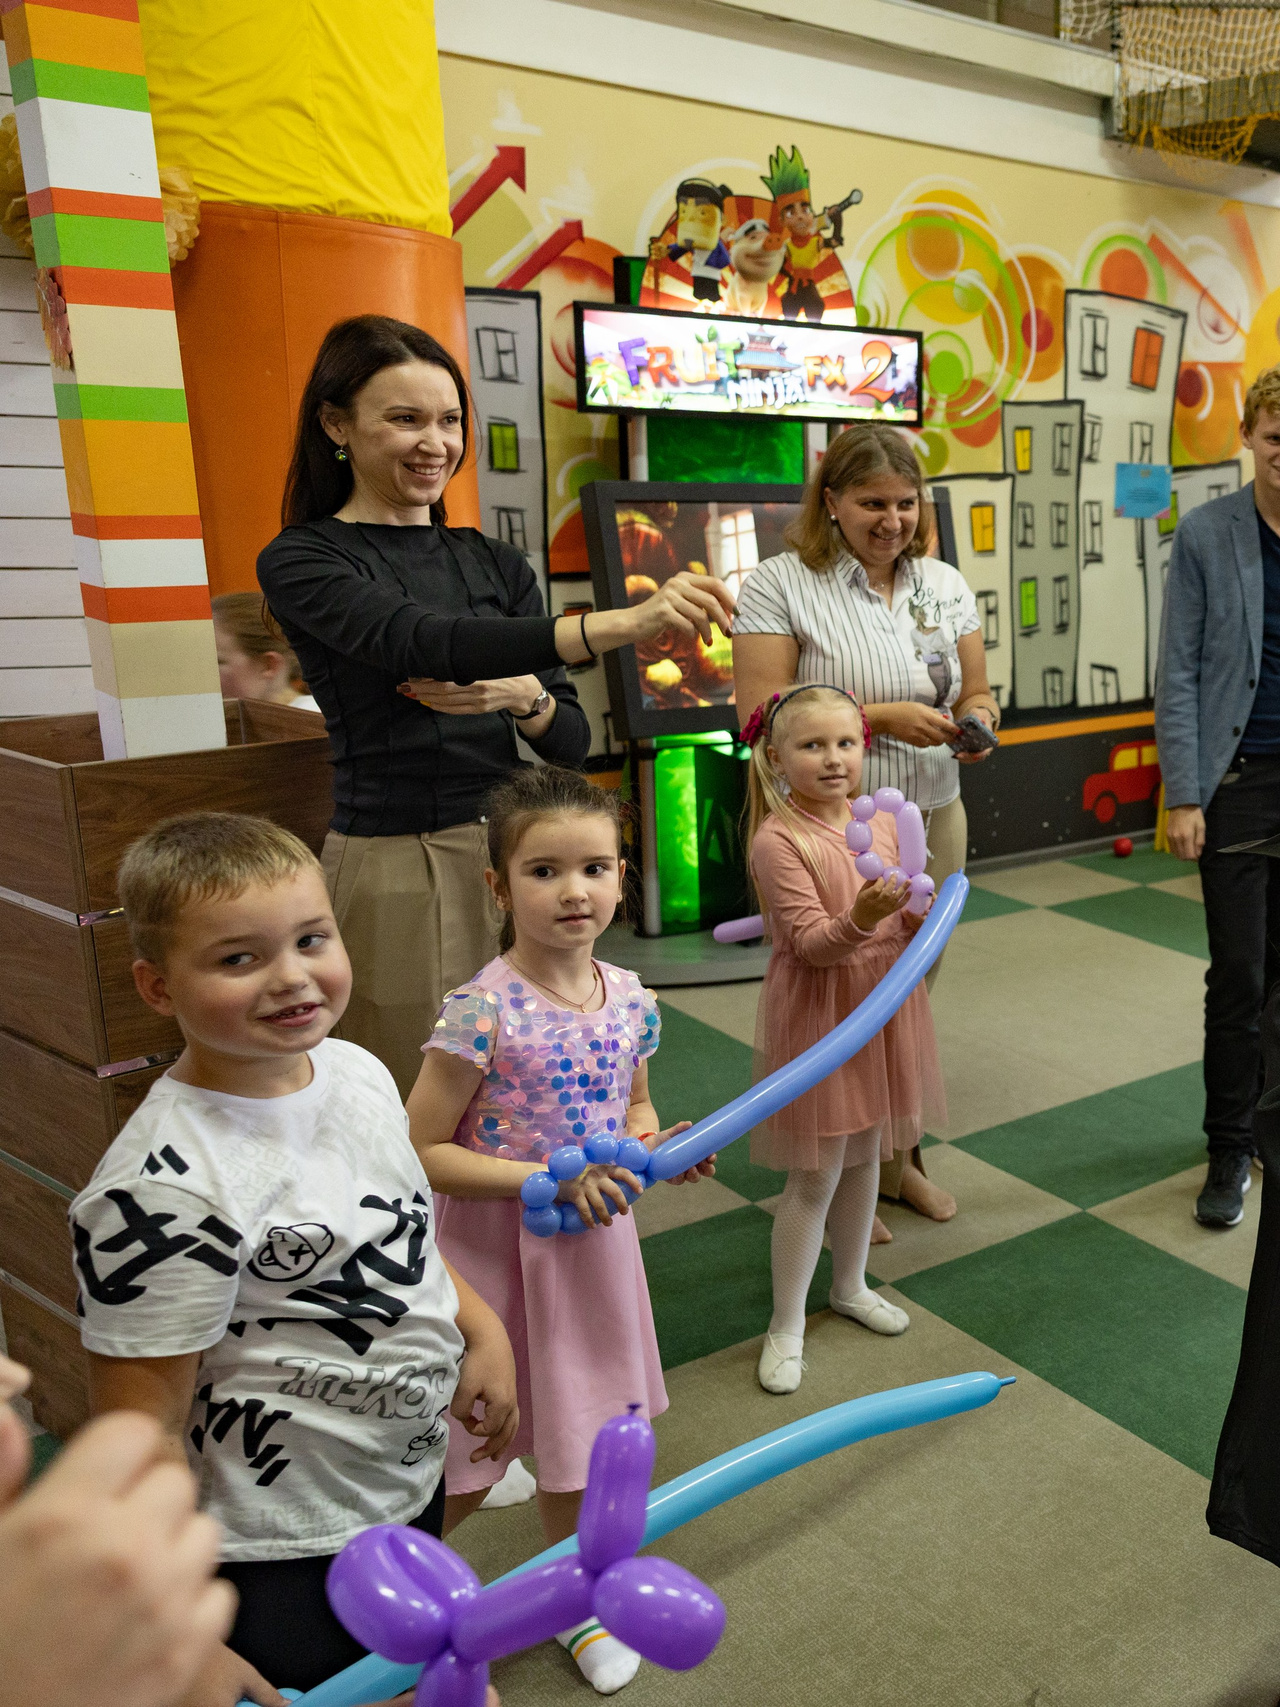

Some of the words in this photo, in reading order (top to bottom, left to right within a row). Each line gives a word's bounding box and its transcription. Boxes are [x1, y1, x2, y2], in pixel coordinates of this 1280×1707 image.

[618, 336, 743, 387] FRUIT
[804, 354, 847, 387] FX
[849, 339, 896, 402] 2
[726, 374, 807, 410] NINJA
[909, 572, 936, 608] Be
[274, 1355, 447, 1420] JOYFUL
